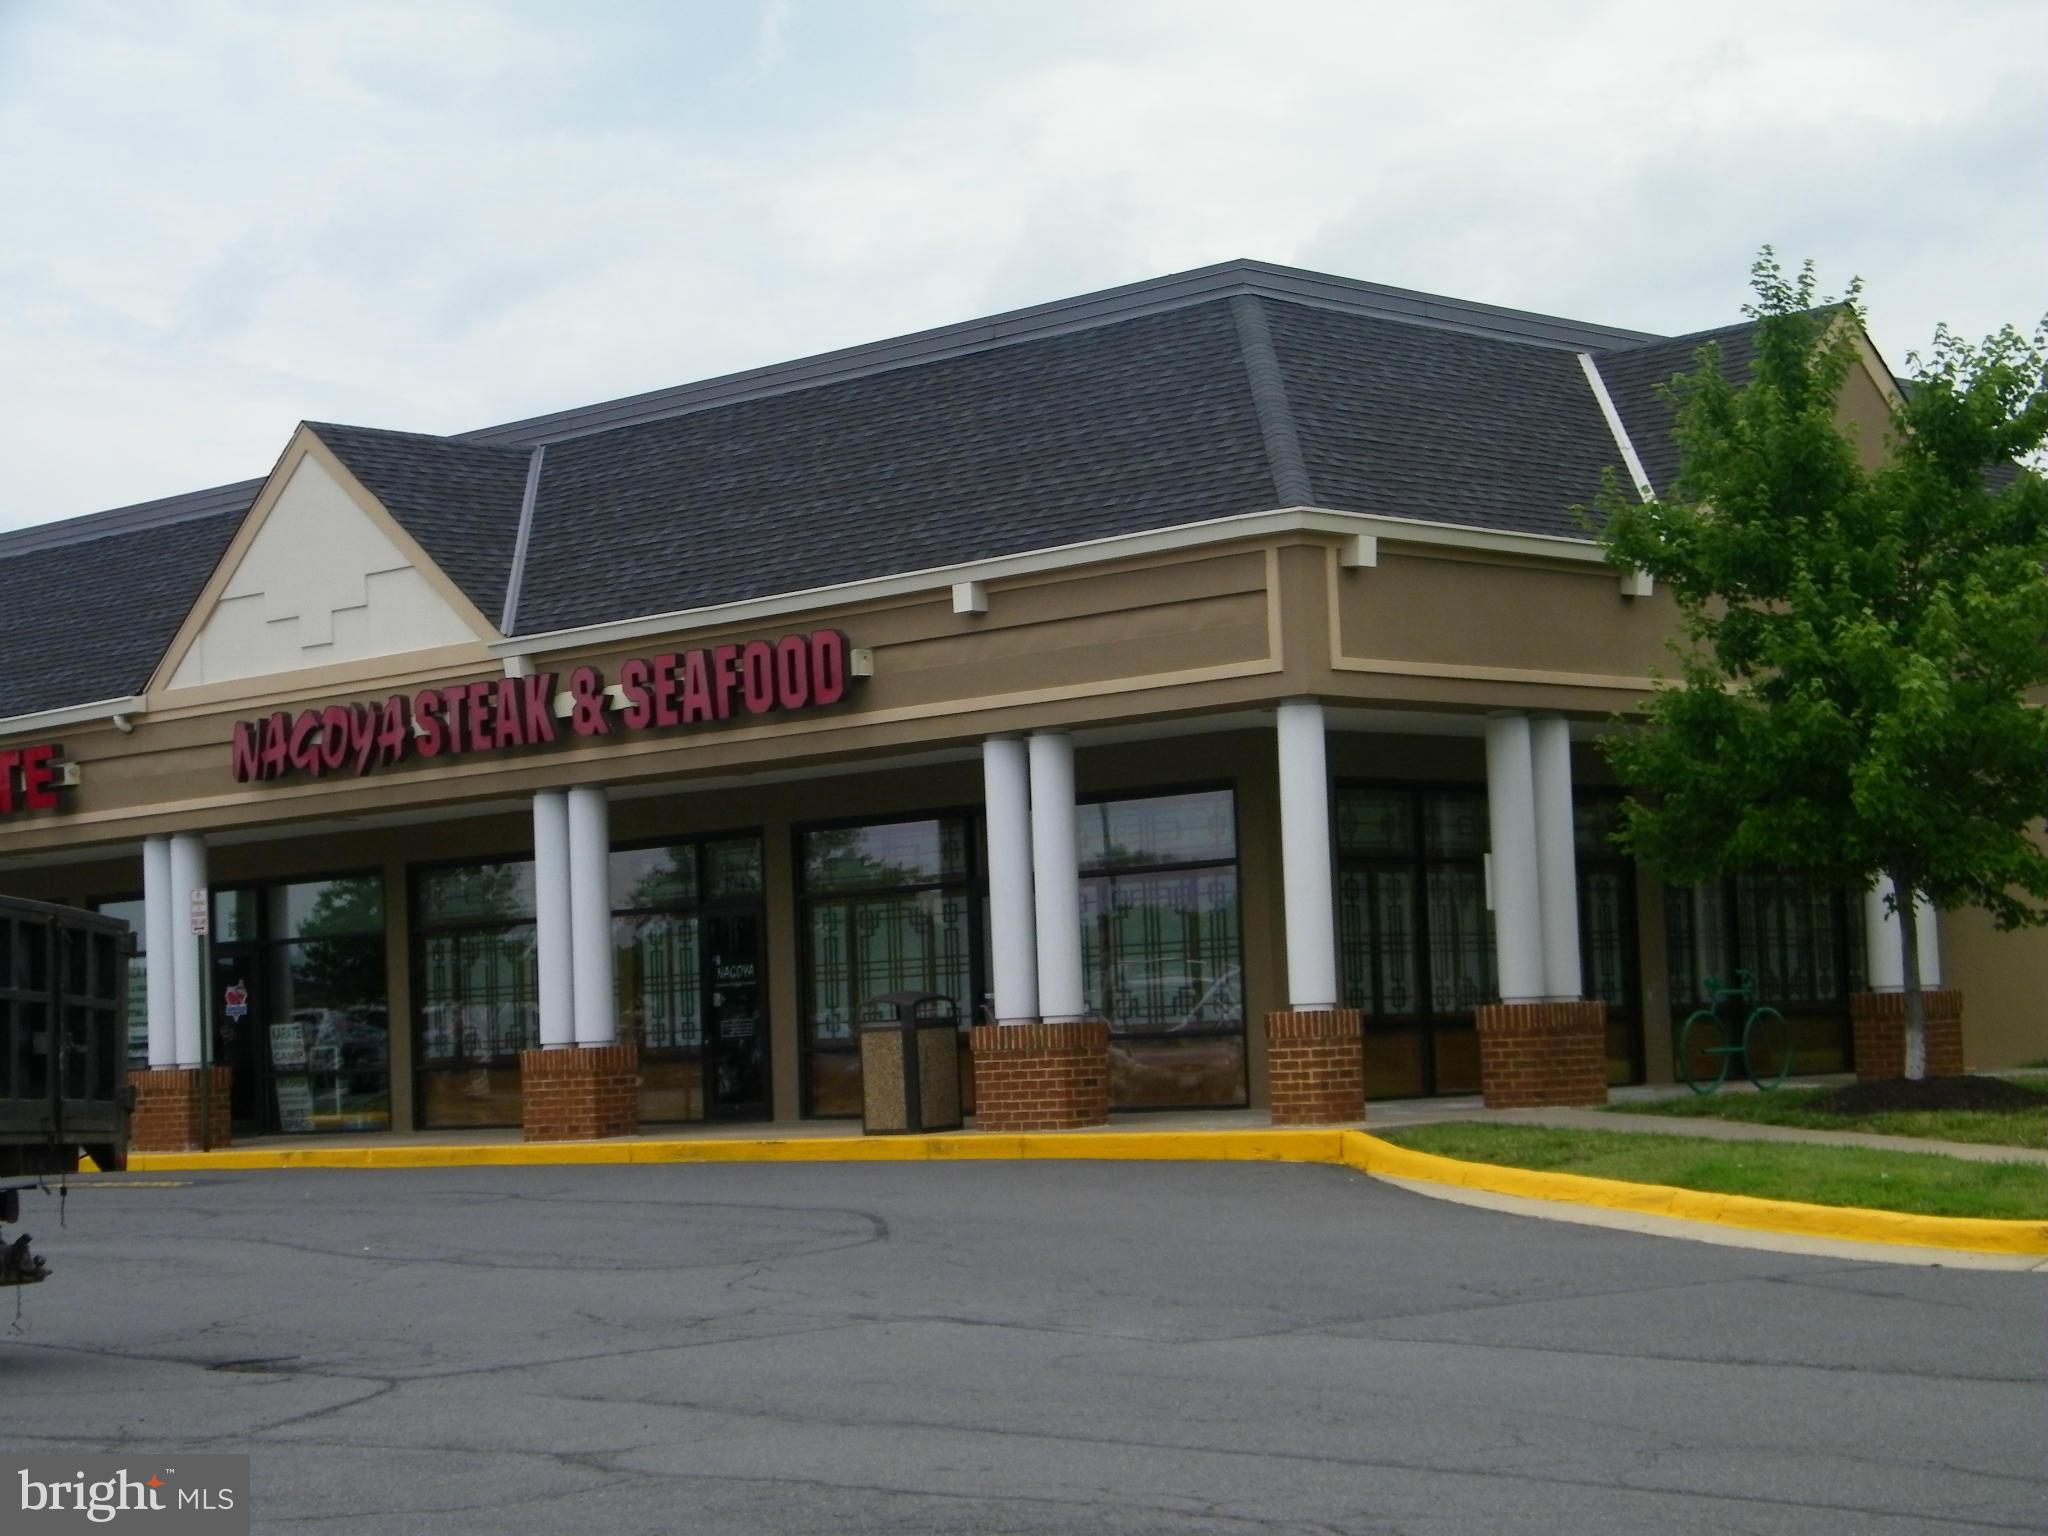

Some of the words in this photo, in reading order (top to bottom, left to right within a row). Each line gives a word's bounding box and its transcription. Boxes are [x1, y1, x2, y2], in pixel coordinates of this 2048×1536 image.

[232, 695, 408, 783] NAGOYA
[414, 672, 555, 757] STEAK
[570, 665, 609, 736] &
[621, 629, 845, 730] SEAFOOD
[716, 964, 755, 978] NAGOYA
